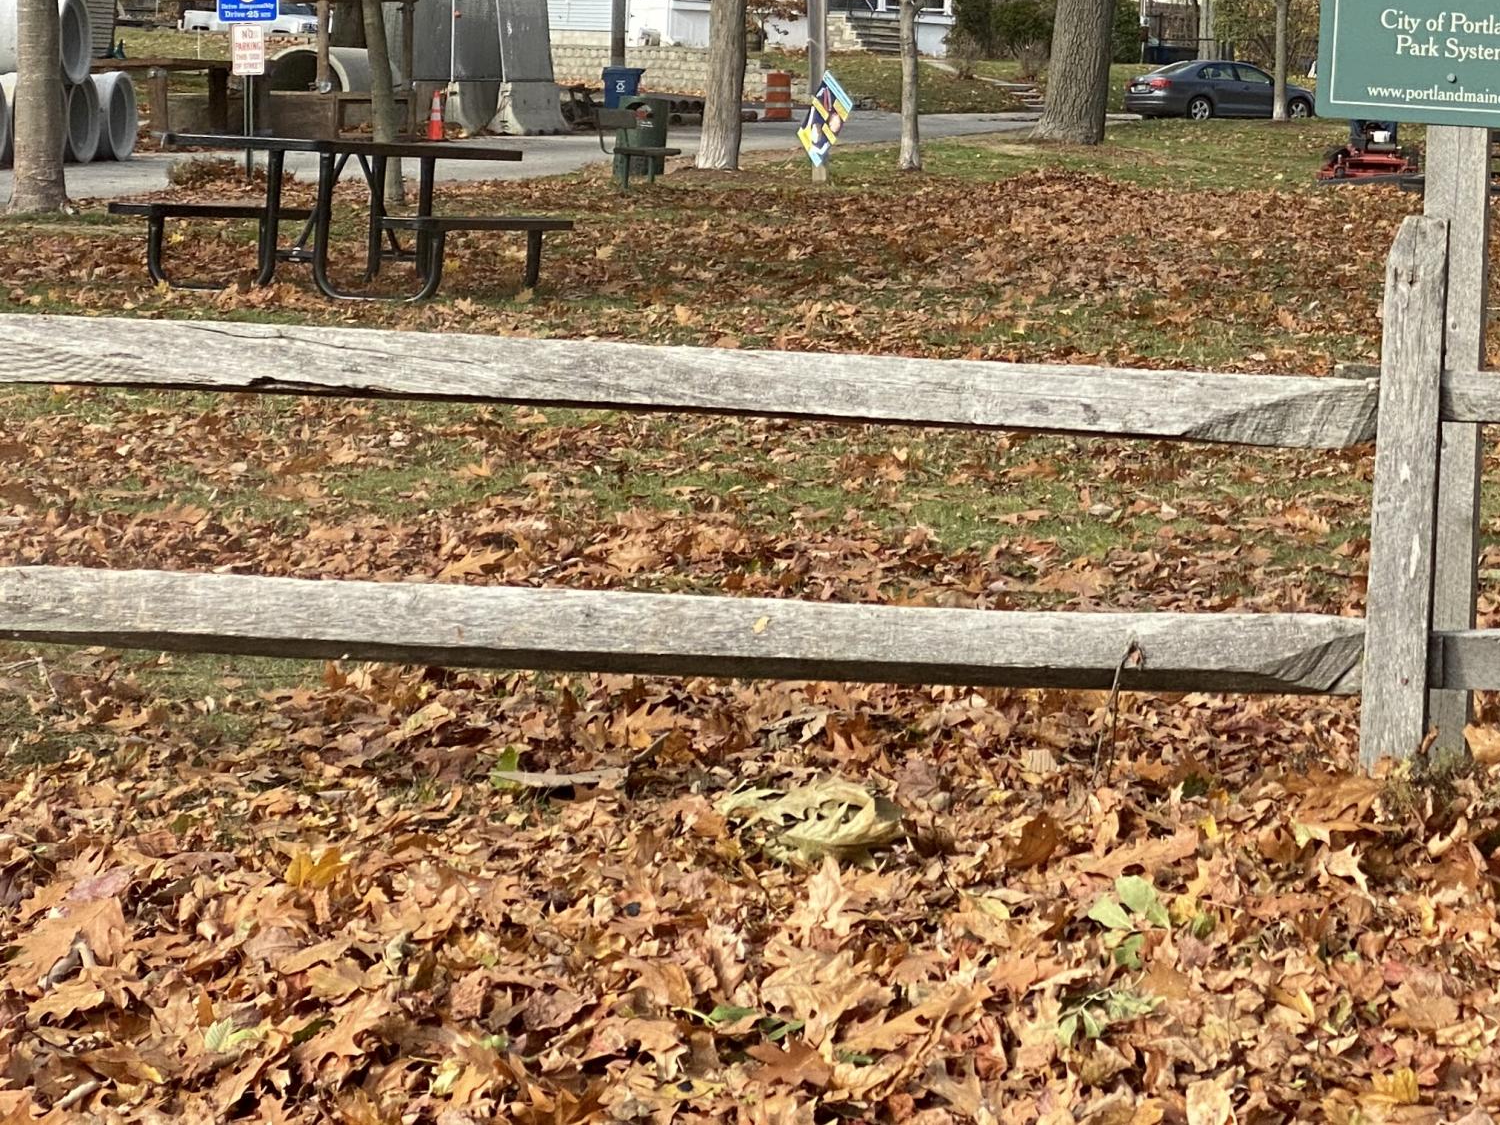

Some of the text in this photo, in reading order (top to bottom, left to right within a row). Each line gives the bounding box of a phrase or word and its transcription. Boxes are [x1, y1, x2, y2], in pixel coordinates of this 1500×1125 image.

[1380, 8, 1421, 34] City
[1426, 12, 1446, 32] of
[241, 29, 254, 39] NO
[235, 42, 261, 51] PARKING
[1396, 35, 1439, 57] Park
